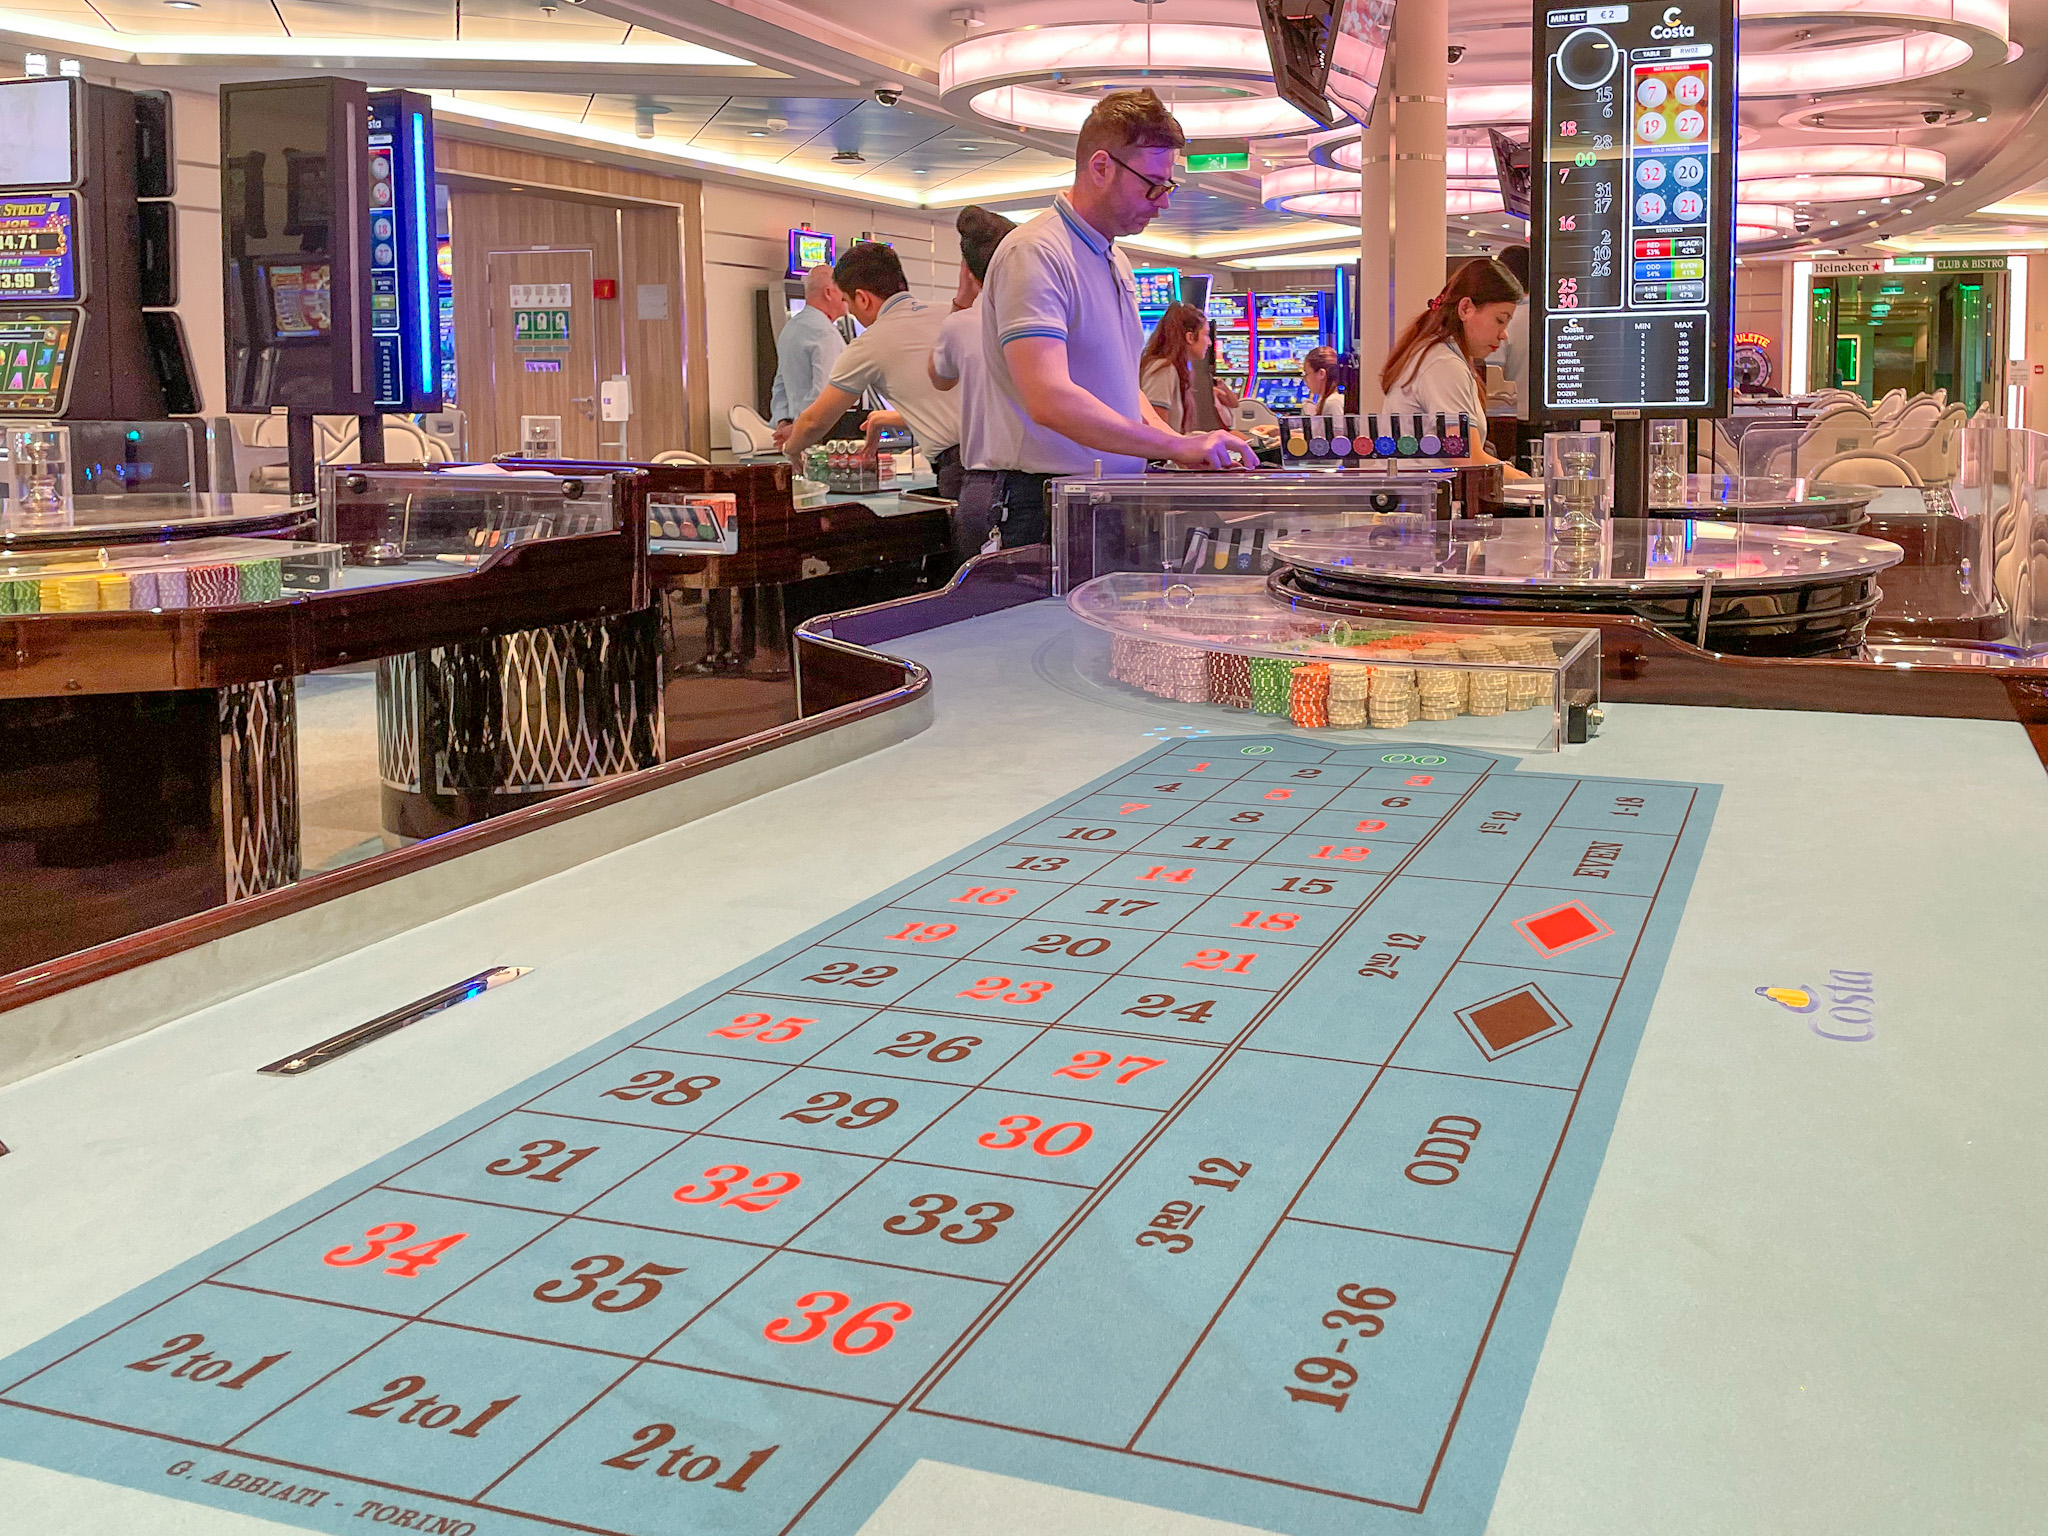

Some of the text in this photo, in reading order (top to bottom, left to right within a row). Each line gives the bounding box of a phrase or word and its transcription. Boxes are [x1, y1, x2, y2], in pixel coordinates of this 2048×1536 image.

[1550, 10, 1614, 23] MIN BET € 2
[1651, 25, 1694, 39] Costa
[1596, 86, 1613, 103] 15
[1648, 84, 1698, 100] 7 14
[1603, 103, 1613, 118] 6
[1560, 121, 1577, 136] 18
[1644, 117, 1698, 134] 19 27
[1593, 135, 1613, 150] 28
[1575, 152, 1596, 167] 00
[1559, 169, 1570, 184] 7
[1642, 165, 1698, 182] 32 20
[1595, 182, 1612, 197] 31
[3, 203, 46, 216] STRIKE
[1594, 198, 1612, 214] 17
[1642, 199, 1695, 215] 34 21
[1559, 216, 1576, 231] 16
[1601, 230, 1611, 244] 2
[1593, 246, 1611, 261] 10
[1591, 261, 1611, 277] 26
[1815, 262, 1869, 273] Heineken
[1937, 260, 1960, 269] CLUB
[1972, 259, 2004, 268] BISTRO
[1, 273, 35, 288] 3,99
[1558, 278, 1577, 293] 25
[1558, 295, 1578, 309] 30
[1381, 753, 1447, 765] 00
[1187, 762, 1435, 786] 1 2 3
[1153, 783, 1412, 808] 4 5 6
[1609, 796, 1645, 817] 1-18
[1119, 802, 1388, 833] 7 8 9
[1489, 811, 1521, 821] 12
[1058, 826, 1371, 862] 10 11 12
[1572, 840, 1624, 879] EVEN
[1006, 855, 1339, 894] 13 14 15
[949, 885, 1301, 932] 16 17 18
[884, 922, 1258, 975] 19 20 21
[1383, 933, 1426, 950] 12
[801, 961, 1218, 1024] 22 23 24
[1807, 969, 1876, 1042] Costa
[708, 1012, 1169, 1085] 25 26 27
[601, 1069, 1094, 1158] 28 29 30
[1404, 1114, 1482, 1186] ODD
[1188, 1157, 1252, 1193] 12
[486, 1138, 1015, 1246] 31 32 33
[322, 1221, 914, 1356] 34 35 36
[1284, 1282, 1397, 1414] 19-36
[202, 1469, 330, 1507] ABBIATI
[353, 1500, 477, 1536] TORINO
